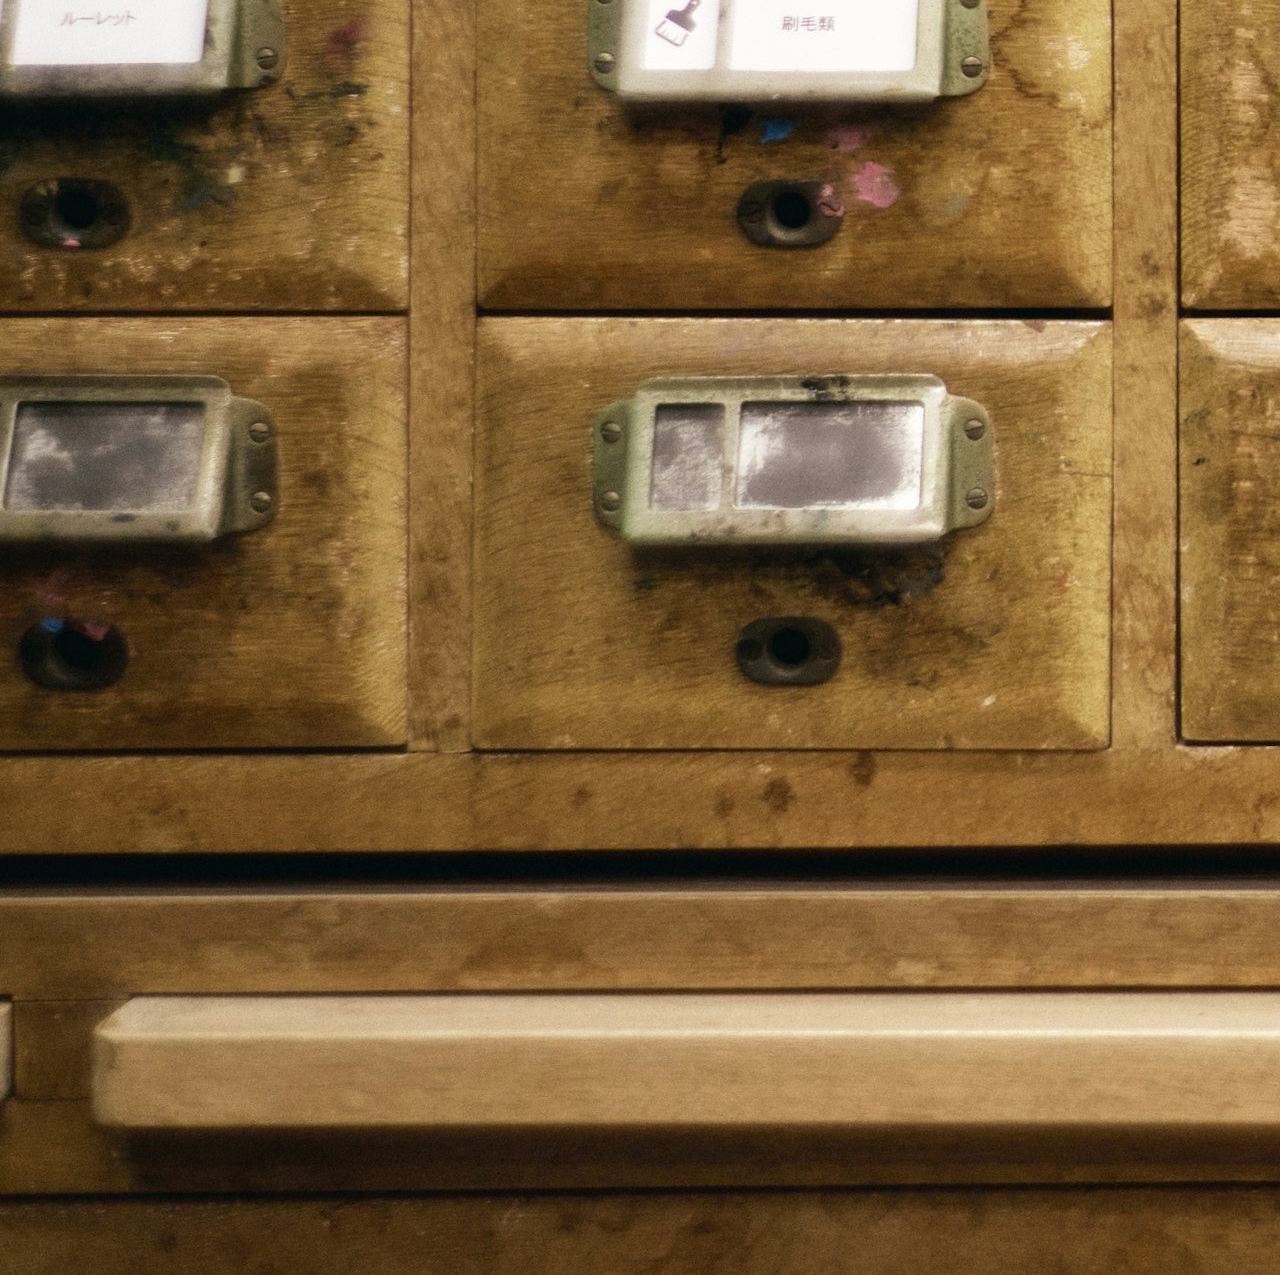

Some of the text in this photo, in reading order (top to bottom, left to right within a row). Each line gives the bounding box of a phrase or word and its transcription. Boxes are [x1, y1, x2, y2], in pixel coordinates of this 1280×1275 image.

[59, 9, 137, 28] ルーレット
[781, 15, 836, 33] 刷毛類
